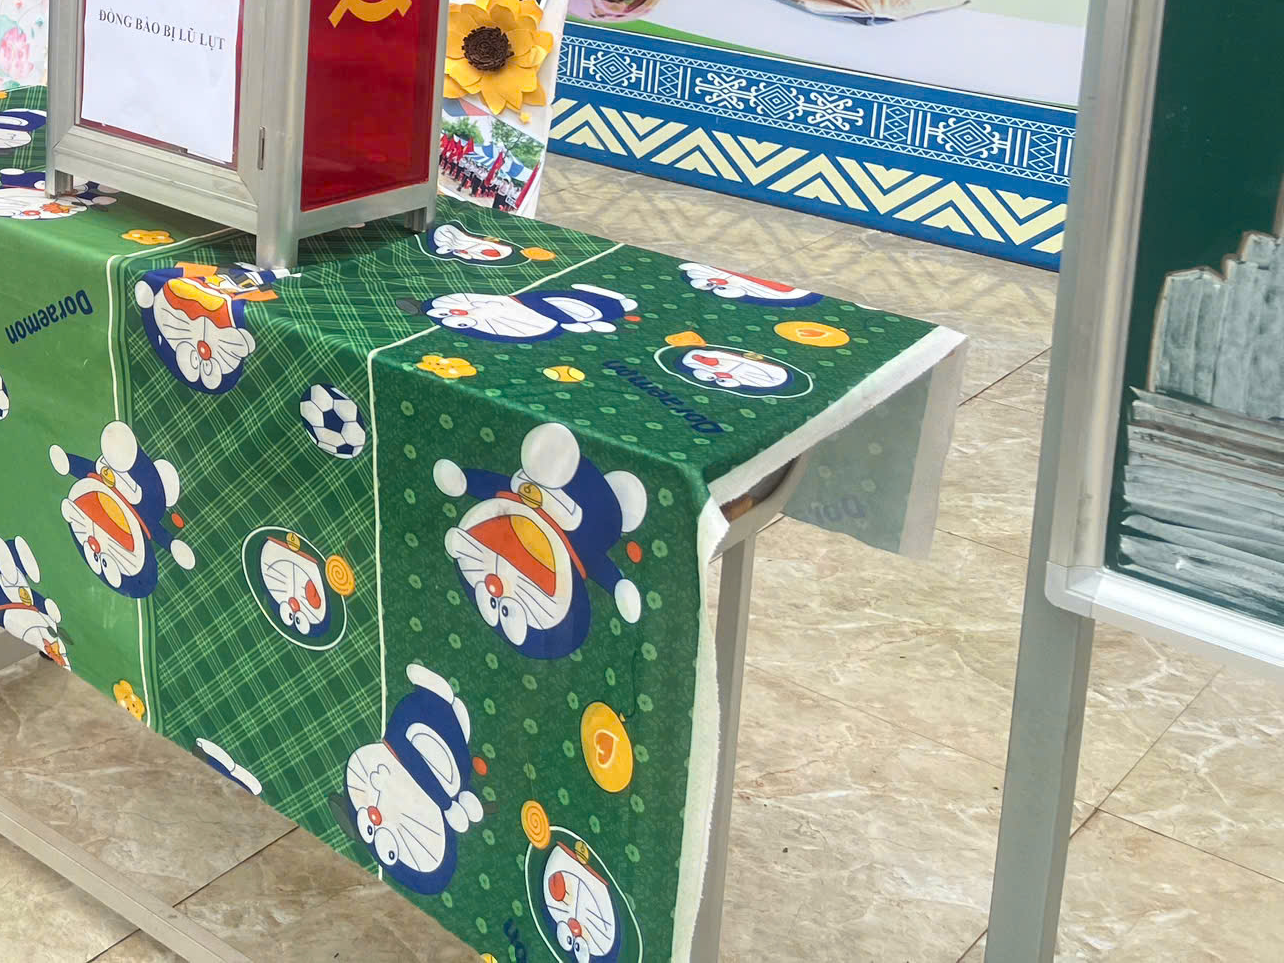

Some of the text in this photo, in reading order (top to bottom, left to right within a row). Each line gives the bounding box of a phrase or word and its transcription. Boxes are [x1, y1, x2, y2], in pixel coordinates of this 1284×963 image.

[98, 6, 226, 51] ĐỒNG BÀO BỊ LŨ LỤT
[4, 289, 94, 345] Doraemon
[603, 360, 725, 434] Doraemon
